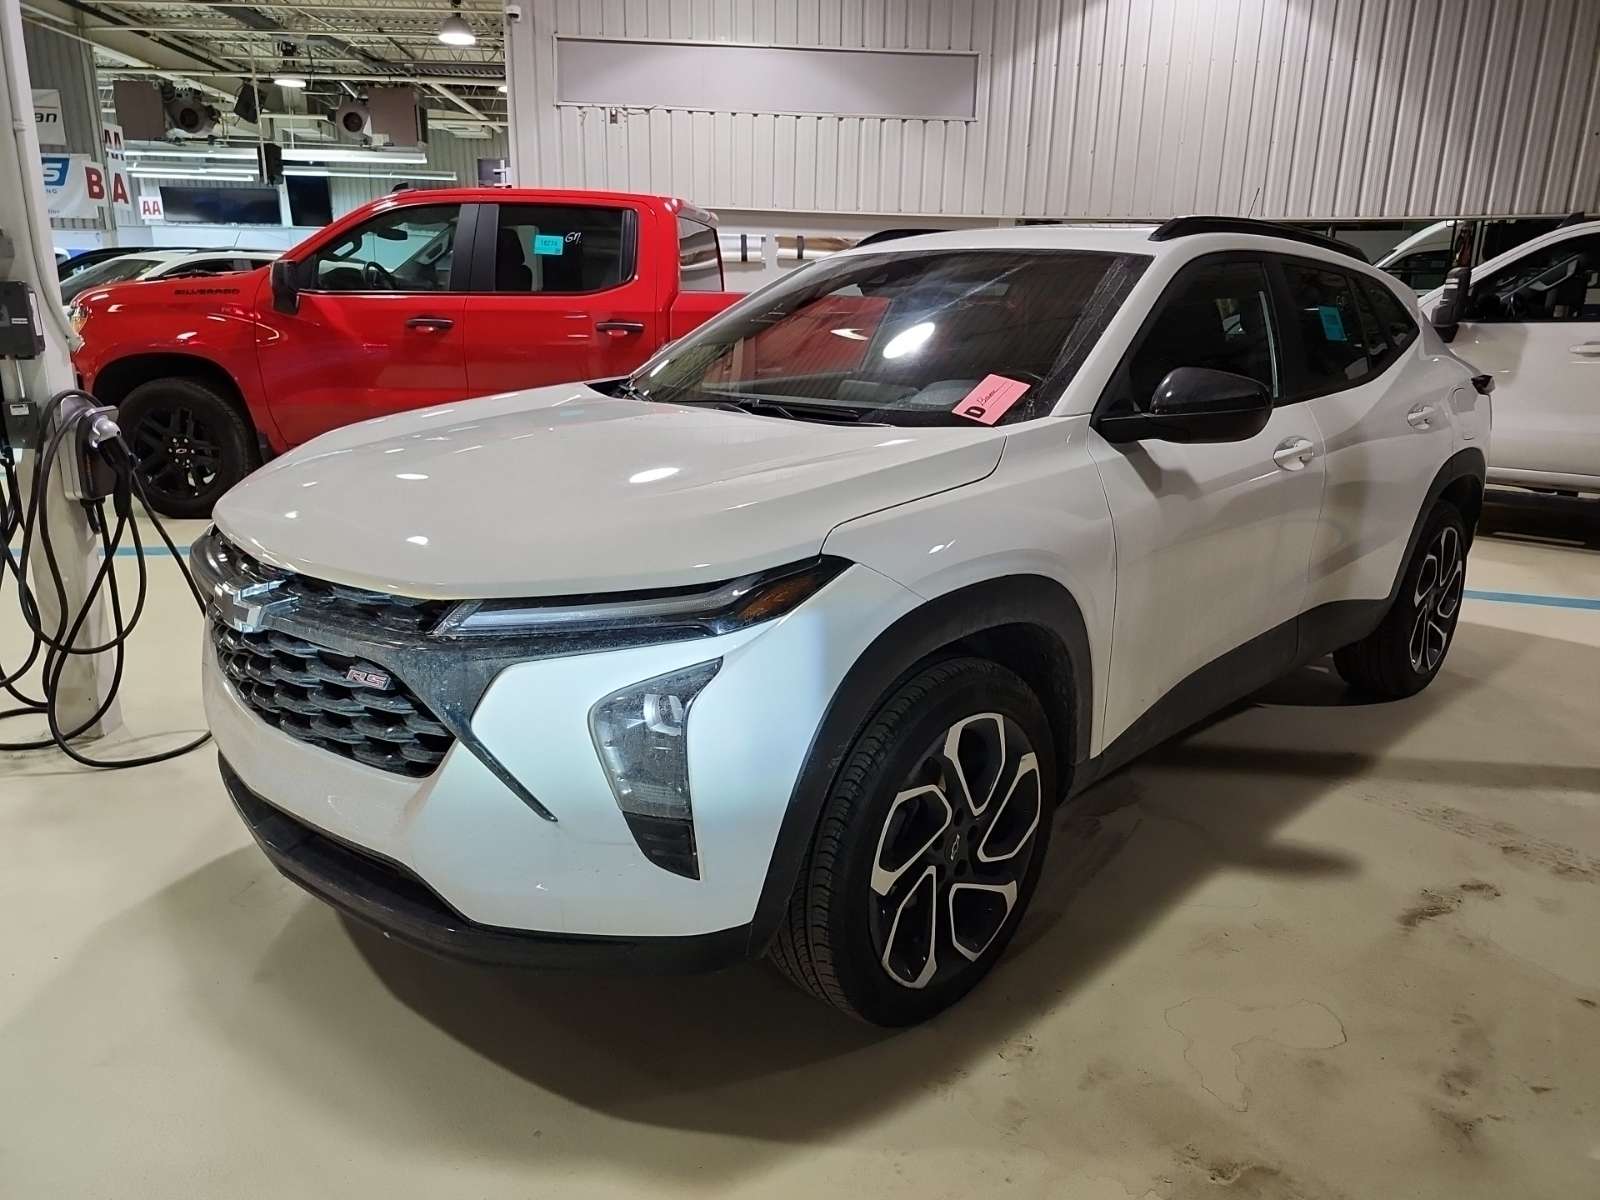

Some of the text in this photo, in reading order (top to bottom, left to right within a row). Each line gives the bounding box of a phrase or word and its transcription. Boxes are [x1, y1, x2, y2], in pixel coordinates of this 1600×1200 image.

[85, 166, 105, 199] B
[112, 172, 130, 204] A
[143, 200, 161, 215] AA
[174, 288, 241, 296] SILVERADO
[964, 406, 986, 418] D
[346, 669, 387, 689] RS
